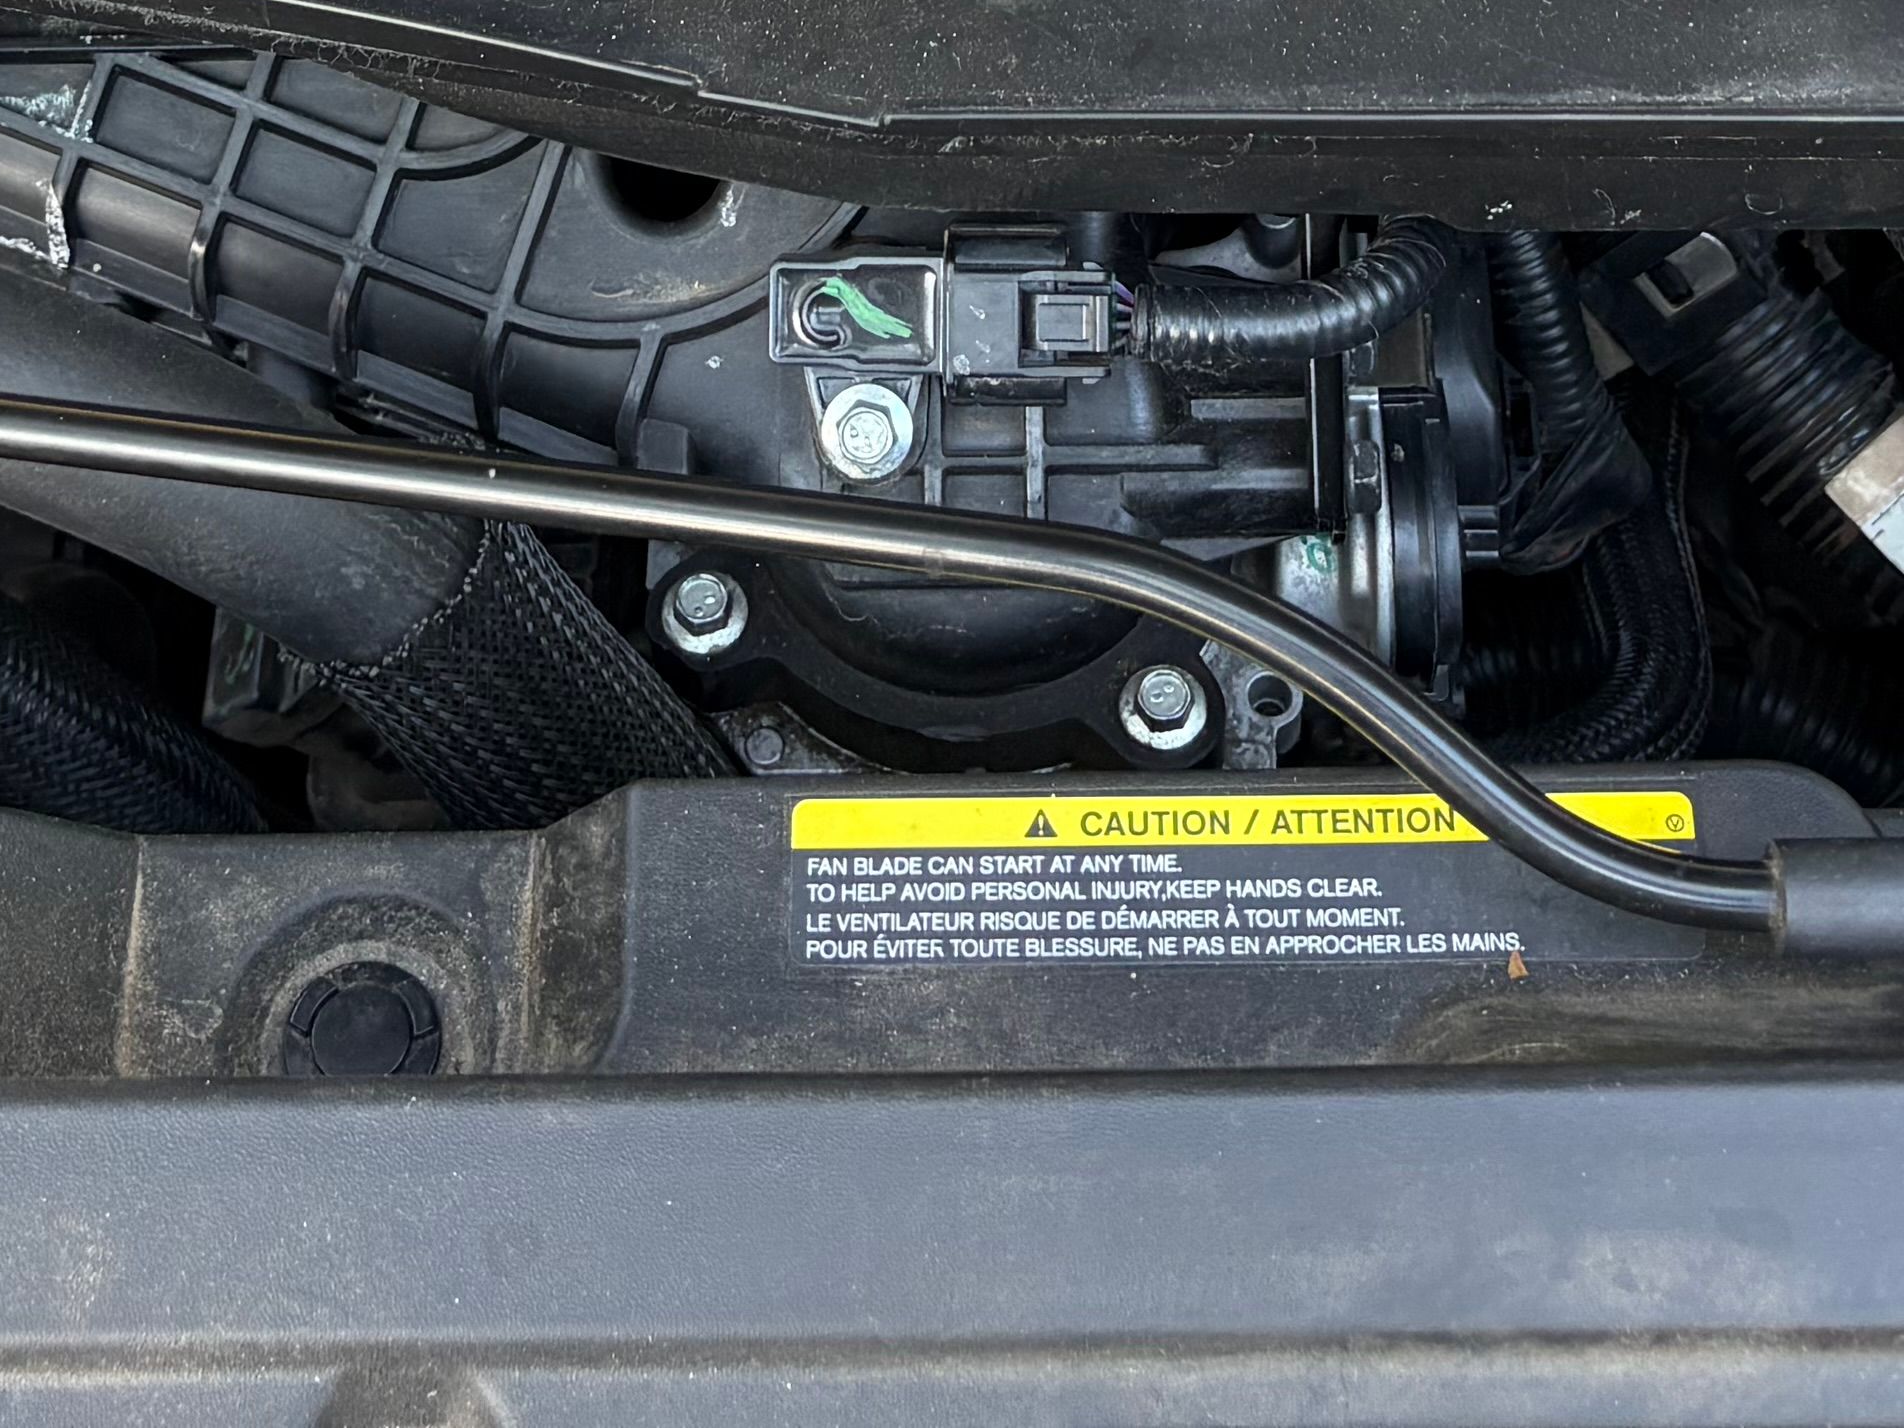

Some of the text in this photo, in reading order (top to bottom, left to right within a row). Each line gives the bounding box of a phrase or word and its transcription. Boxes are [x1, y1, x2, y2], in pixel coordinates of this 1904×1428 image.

[1080, 806, 1456, 836] CAUTION / ATTENTION
[808, 854, 1183, 876] FAN BLADE CAN START AT ANY TIME.
[806, 883, 835, 902] TO
[841, 882, 896, 902] HELP
[900, 882, 965, 902] AVOID
[971, 881, 1086, 901] PERSONAL
[1226, 878, 1302, 898] HANDS
[1307, 878, 1382, 897] CLEAR.
[806, 903, 1405, 932] LE VENTILATEUR RISQUE DE DÉMARRER À TOUT MOMENT.
[806, 932, 1525, 959] POUR ÉVITER TOUTE BLESSURE, NE PAS EN APPROCHER LES MAINS.
